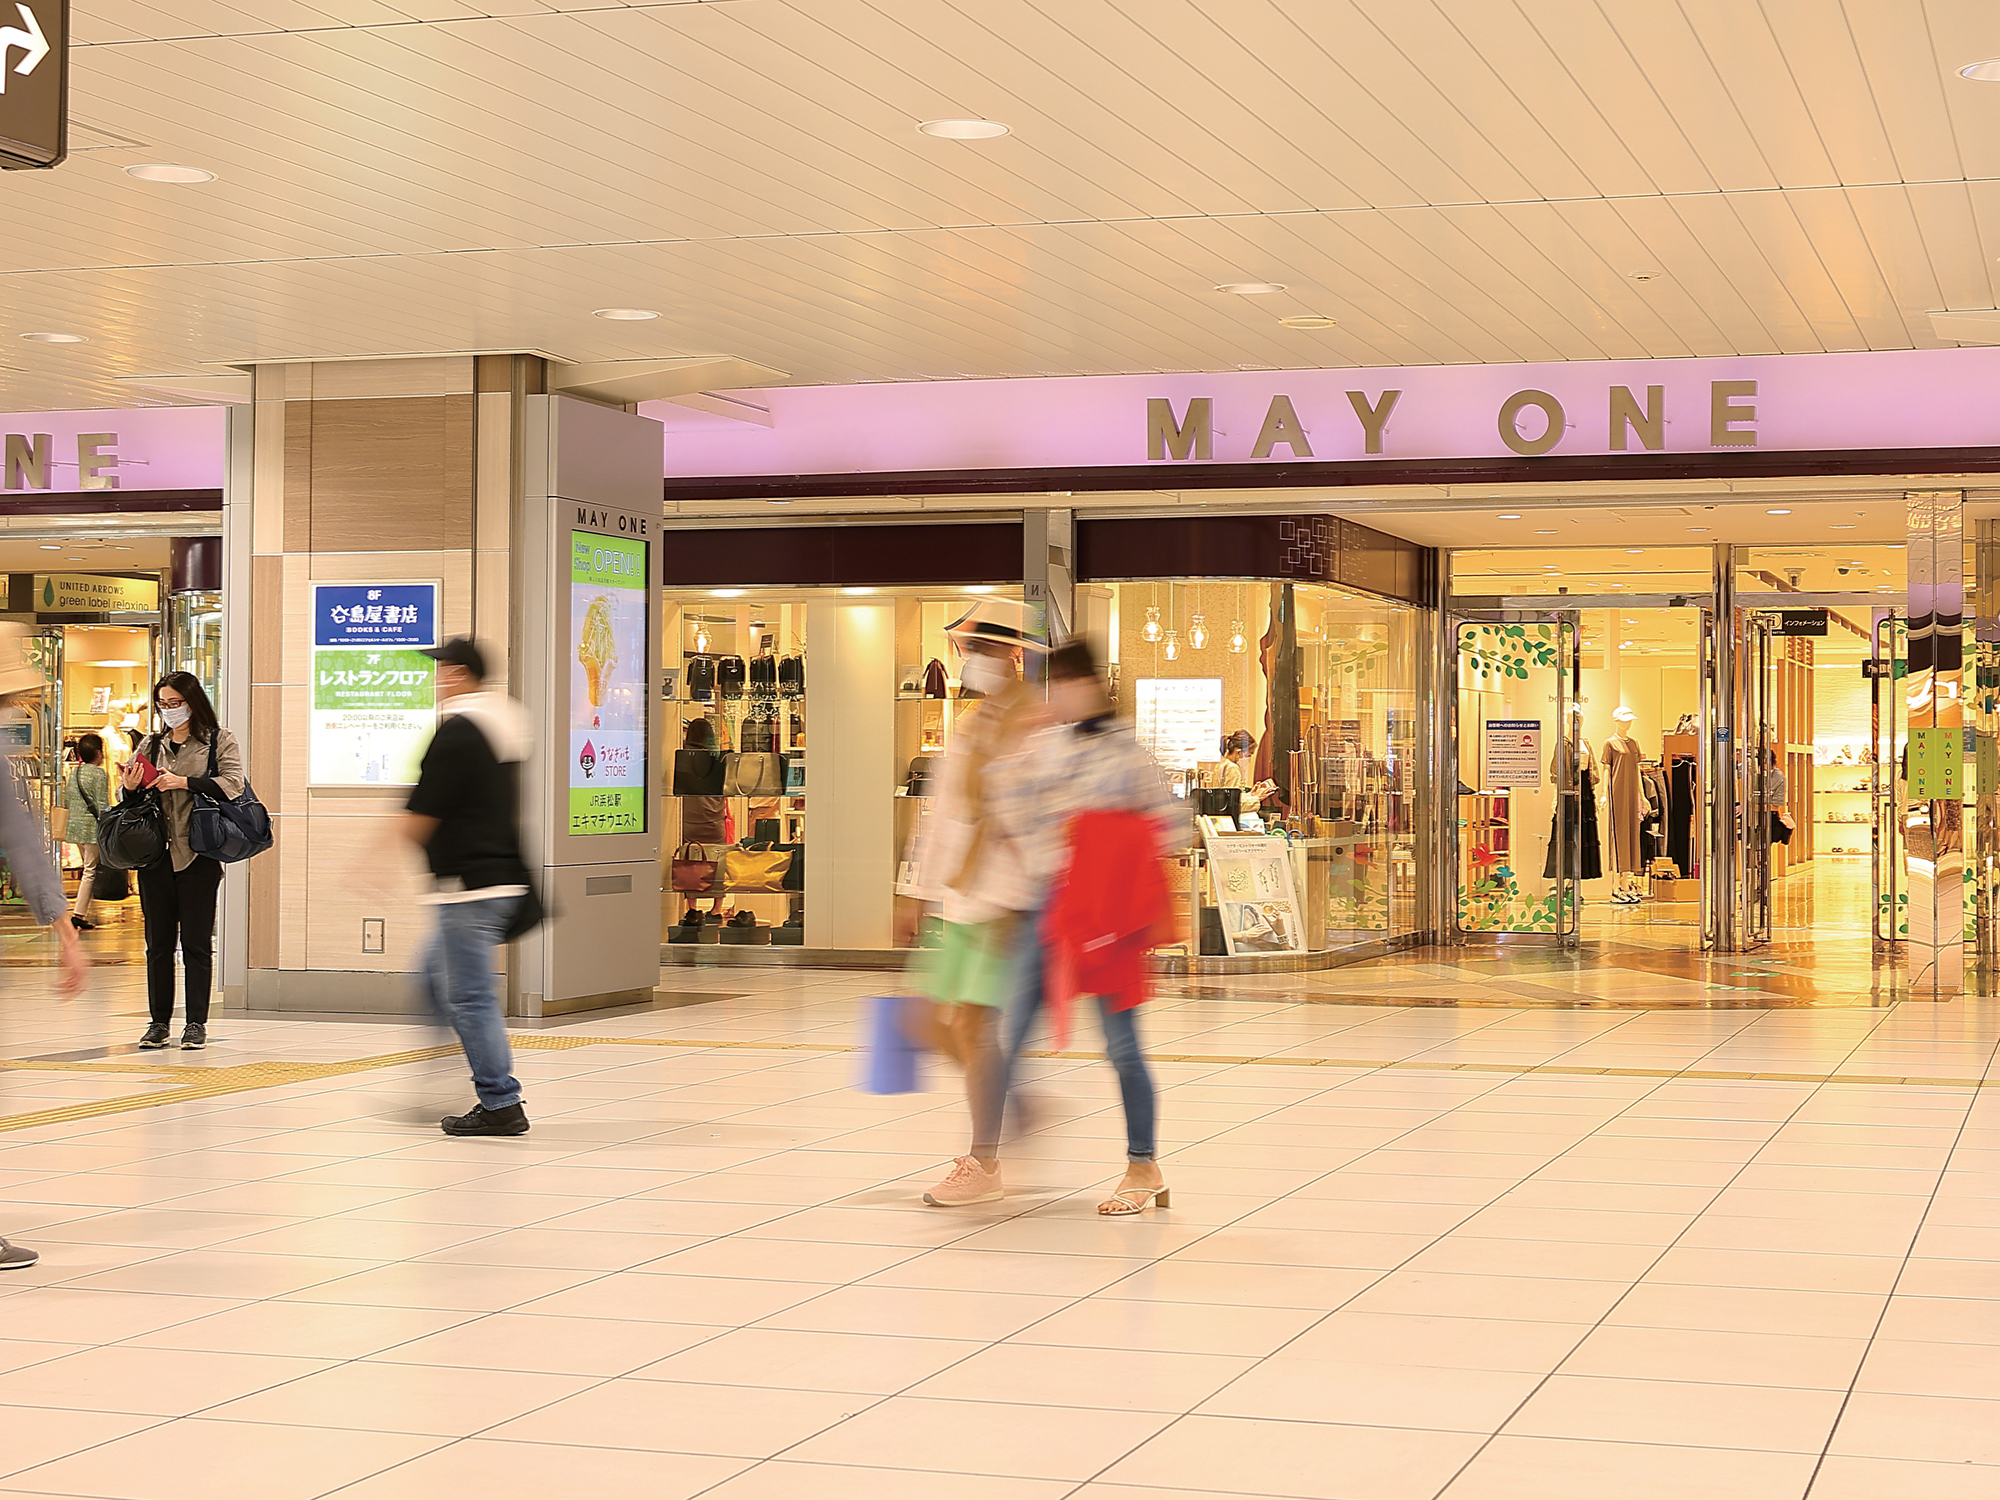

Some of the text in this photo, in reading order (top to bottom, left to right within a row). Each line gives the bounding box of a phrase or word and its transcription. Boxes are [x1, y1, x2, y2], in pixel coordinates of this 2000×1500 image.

[1146, 379, 1758, 461] MAY ONE
[577, 507, 647, 535] MAY ONE
[575, 540, 591, 555] New
[573, 556, 592, 575] Shop
[593, 547, 641, 578] OPEN!!
[60, 581, 125, 595] UNITED ARROWS
[366, 589, 383, 601] 8F
[59, 596, 150, 611] green label relaxing
[330, 604, 419, 624] 谷島屋書店
[1783, 619, 1826, 627] インフォメーション
[366, 653, 381, 665] 7F
[320, 669, 429, 686] レストランフロア
[600, 745, 630, 763] うなぎいも
[605, 765, 627, 777] STORE
[1917, 732, 1926, 795] MAY ONE
[1944, 732, 1953, 795] MAY ONE
[590, 793, 622, 807] JR浜松駅
[572, 812, 637, 829] エキマチウエスト
